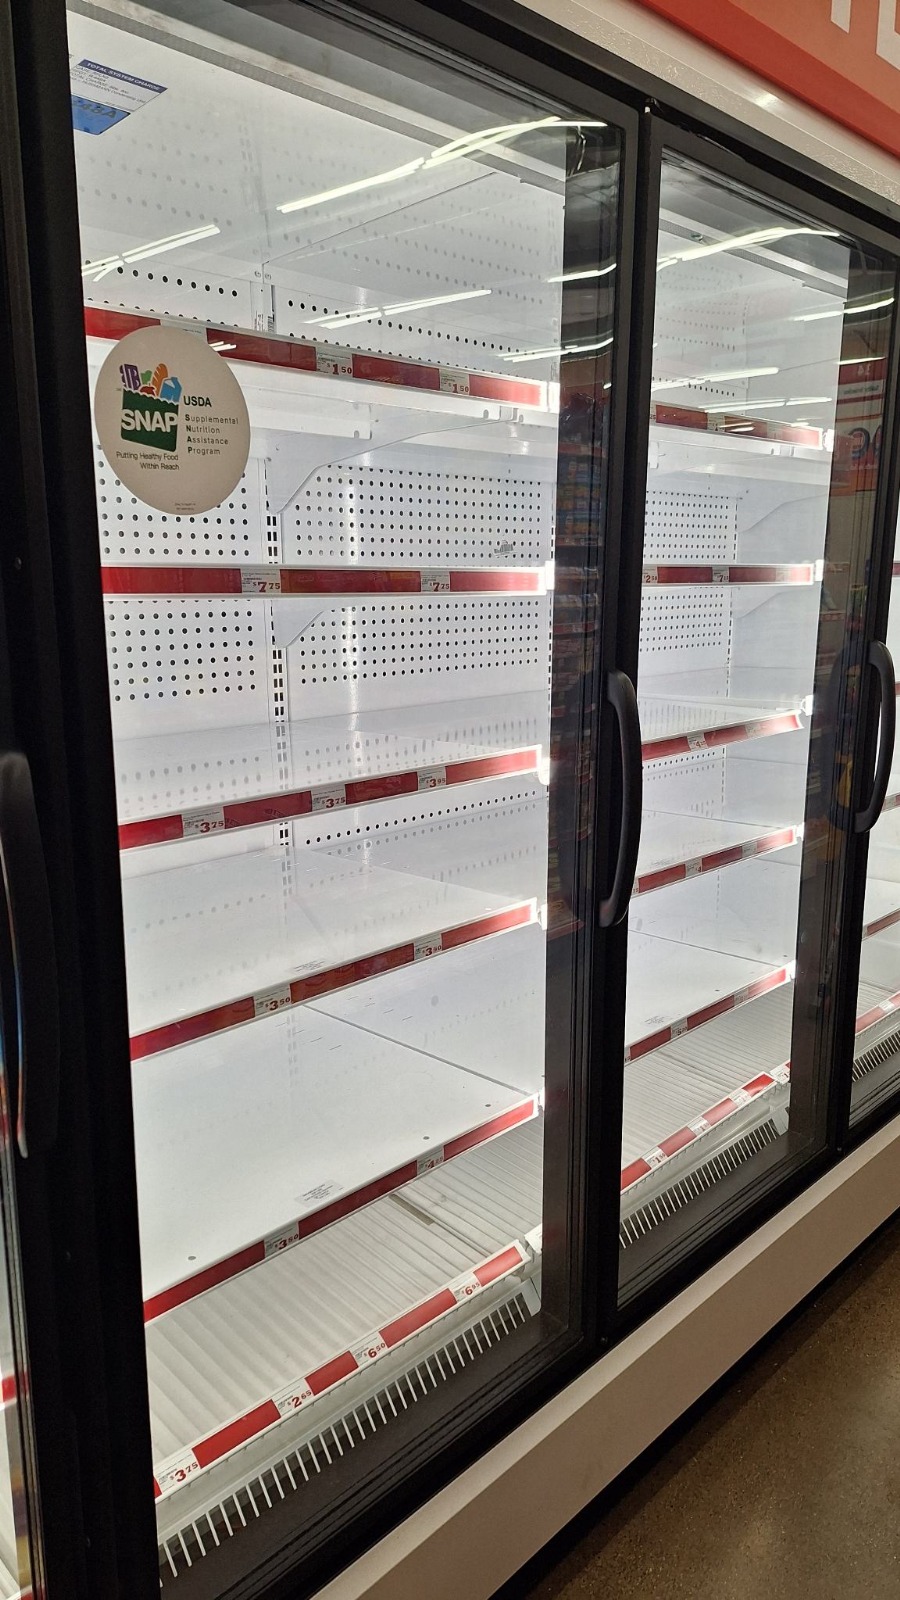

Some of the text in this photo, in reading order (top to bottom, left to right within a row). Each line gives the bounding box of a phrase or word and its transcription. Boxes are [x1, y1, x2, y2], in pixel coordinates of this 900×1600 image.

[87, 63, 107, 73] TOTAL
[108, 70, 135, 83] SYSTEM
[134, 78, 160, 91] CHARGE
[183, 396, 212, 407] USDA
[121, 409, 178, 433] SNAP
[185, 414, 239, 425] Supplemental
[186, 425, 221, 434] Nutrition
[187, 435, 229, 445] Assistance
[116, 451, 179, 461] Putting Healthy Food
[188, 446, 221, 456] Program
